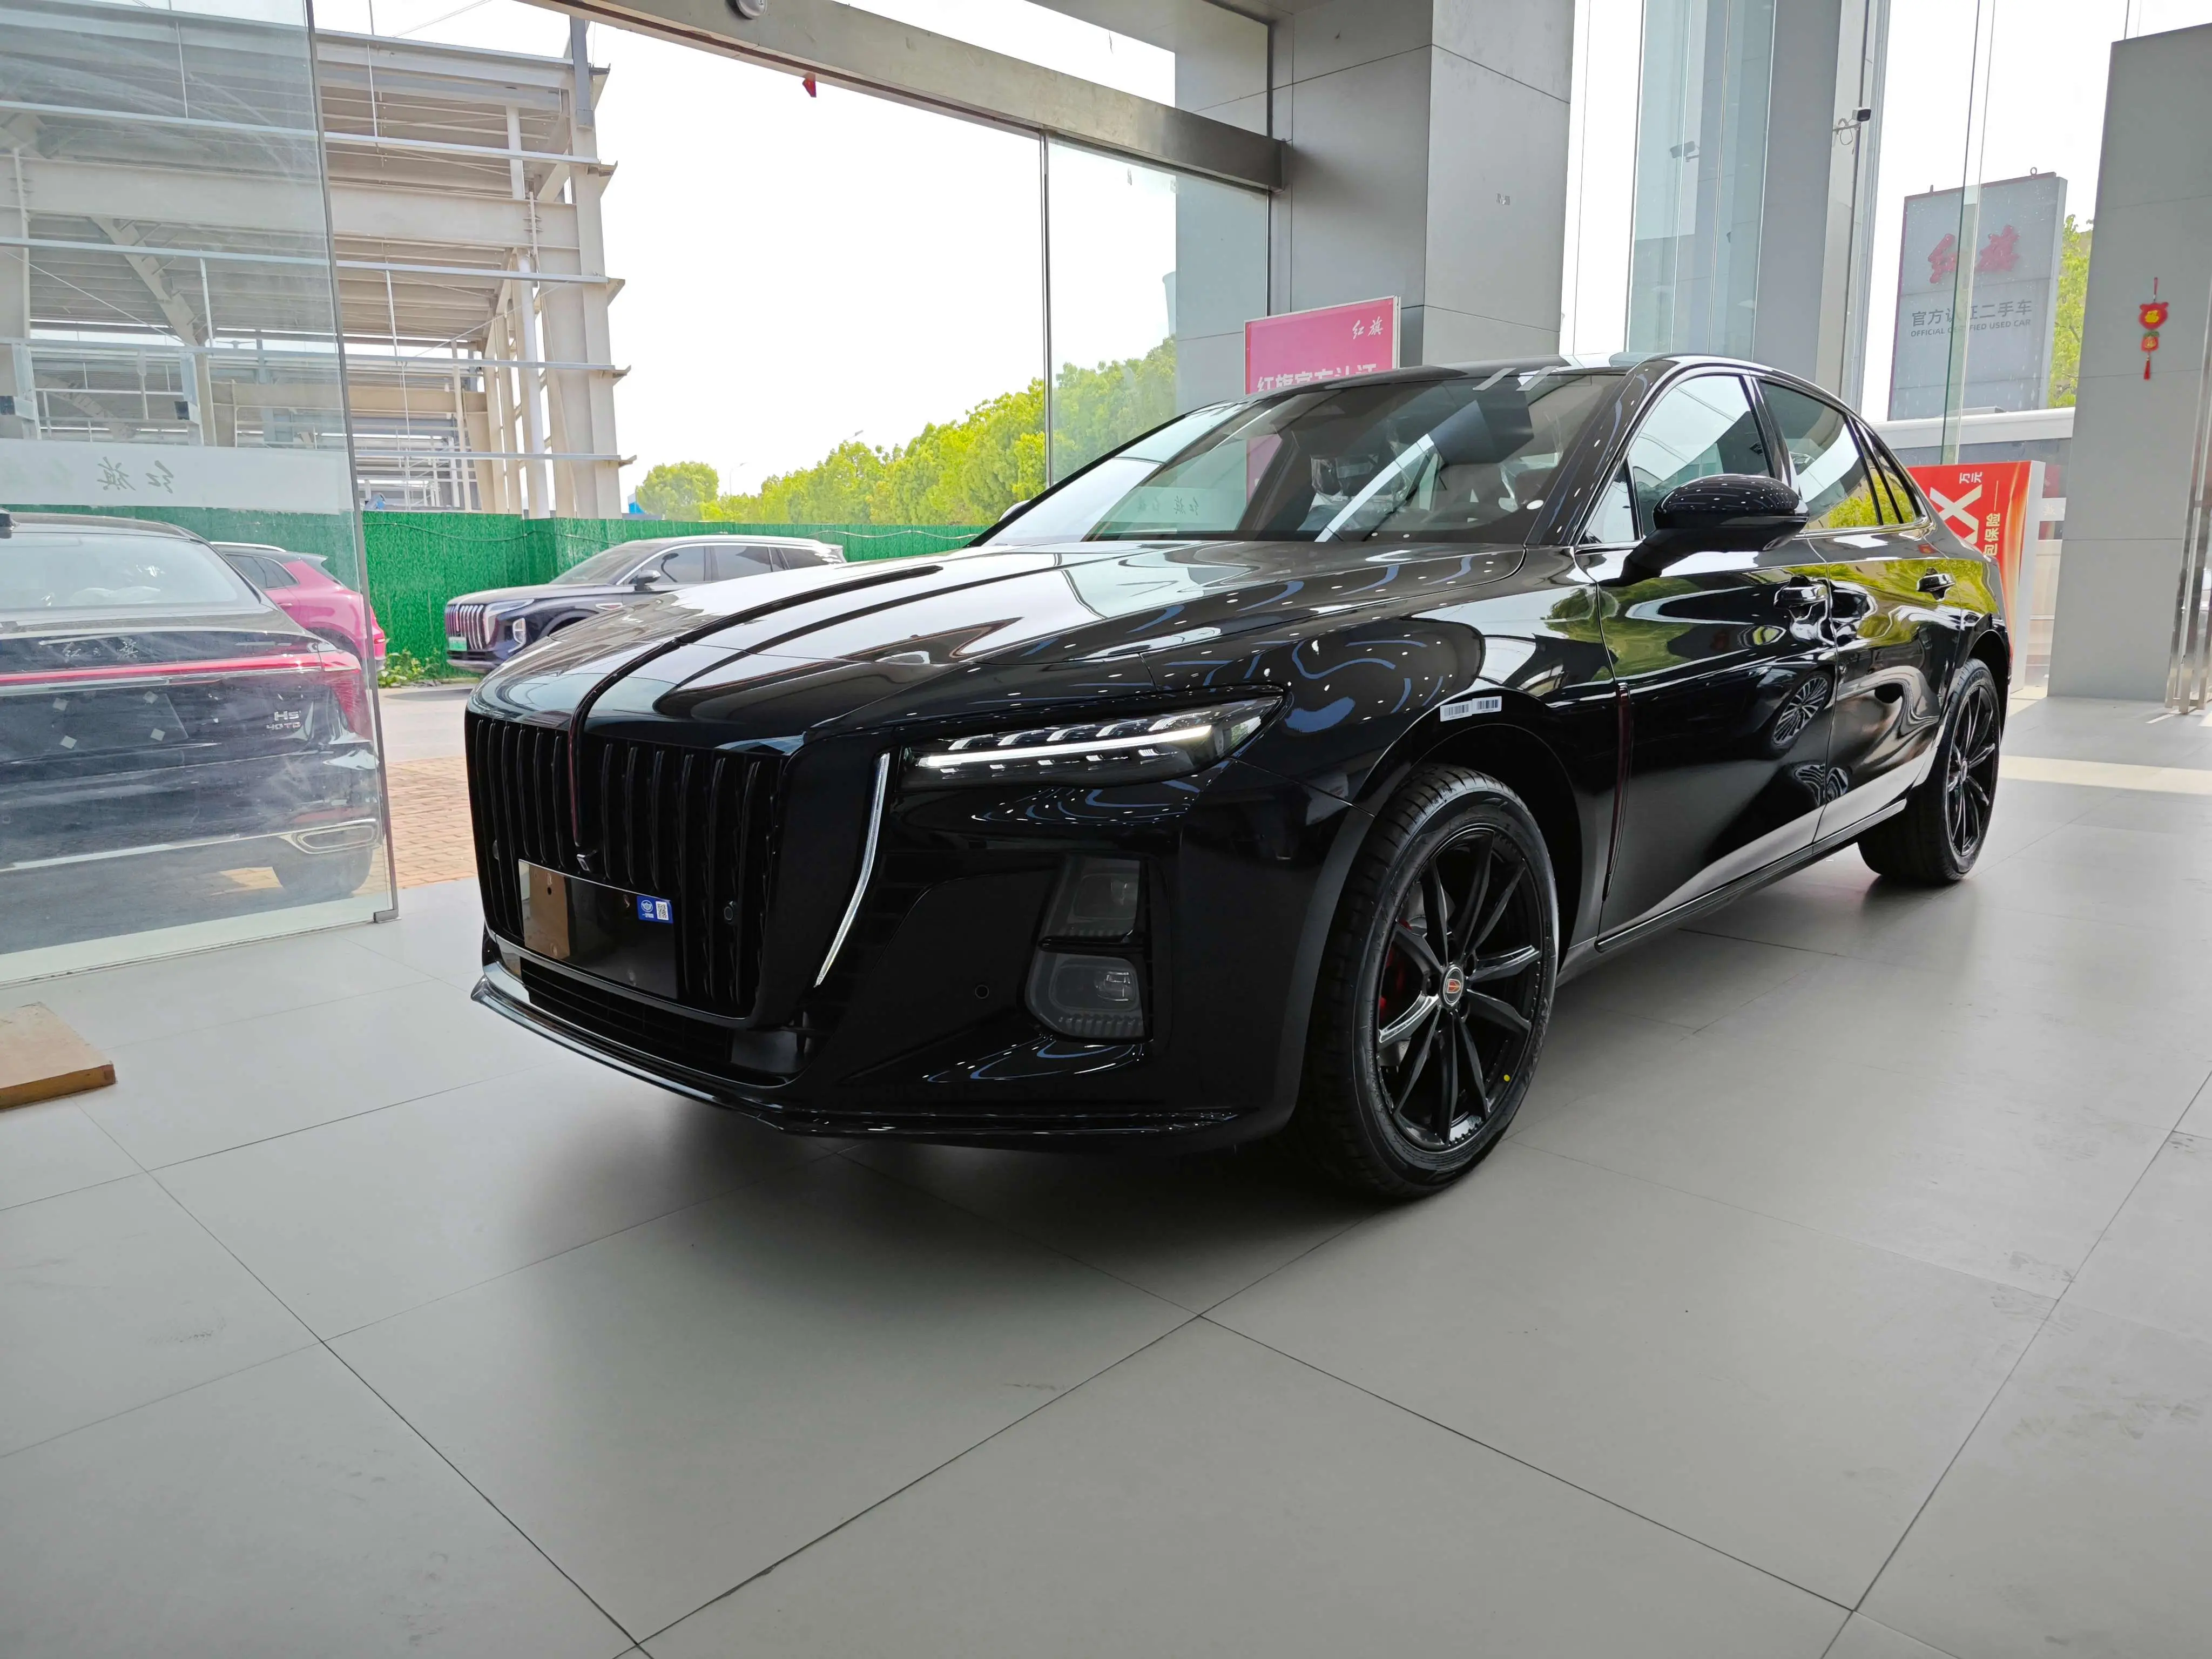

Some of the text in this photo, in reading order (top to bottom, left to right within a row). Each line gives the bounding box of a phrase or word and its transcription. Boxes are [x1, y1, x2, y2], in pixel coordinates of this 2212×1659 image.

[1352, 316, 1383, 340] 红旗
[1911, 319, 2031, 336] OFFICIAL CERTFIED USED CAR
[1959, 471, 1983, 484] 万元
